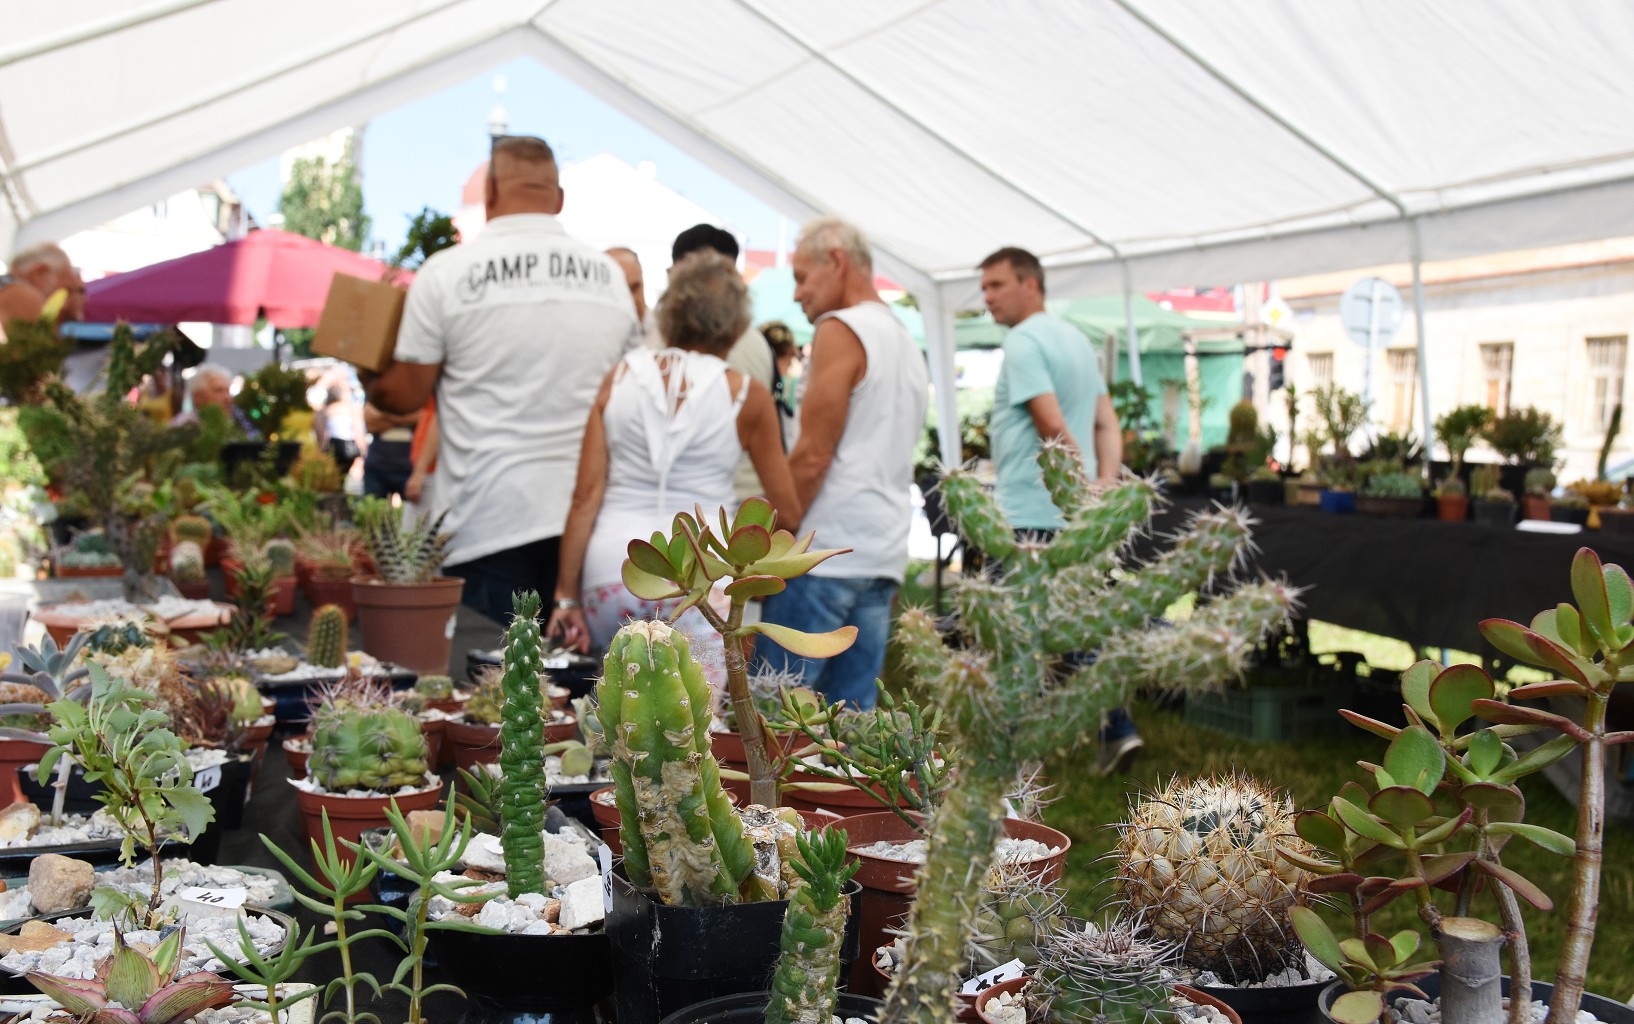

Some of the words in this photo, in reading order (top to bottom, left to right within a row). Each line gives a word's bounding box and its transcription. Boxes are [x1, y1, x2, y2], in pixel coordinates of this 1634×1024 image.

[468, 253, 539, 290] CAMP
[549, 252, 611, 284] DAVID
[195, 891, 225, 903] 40
